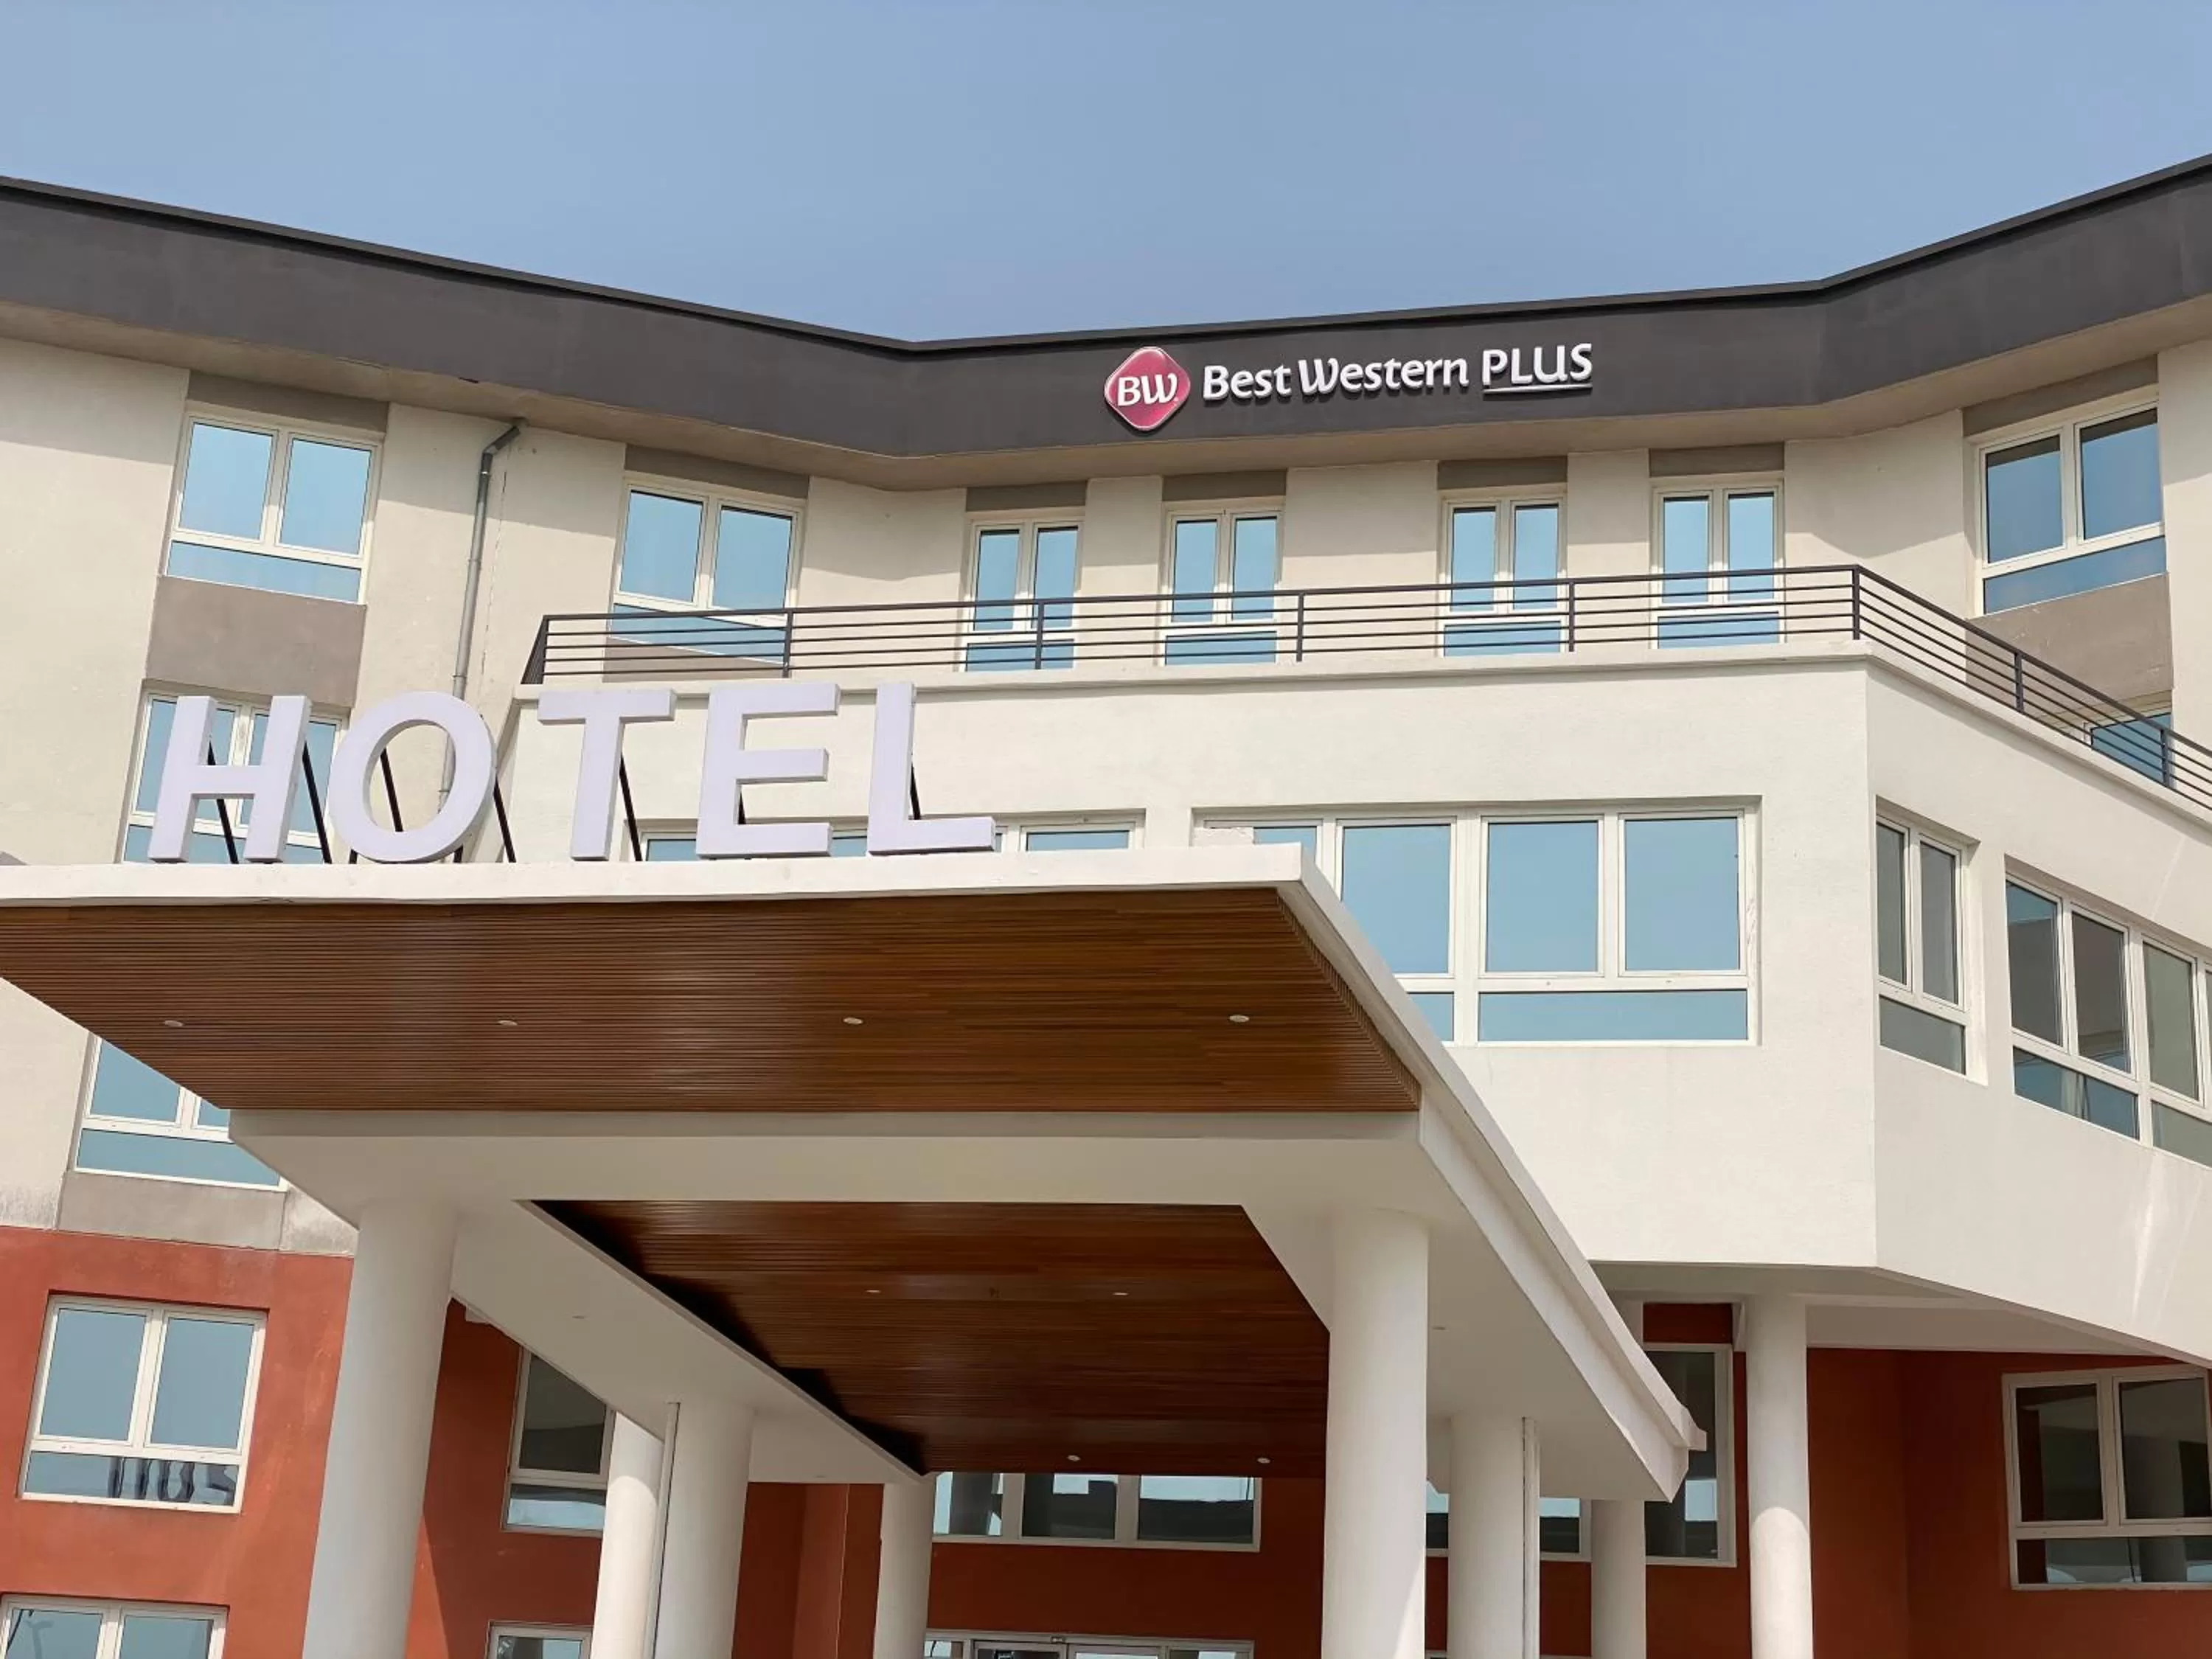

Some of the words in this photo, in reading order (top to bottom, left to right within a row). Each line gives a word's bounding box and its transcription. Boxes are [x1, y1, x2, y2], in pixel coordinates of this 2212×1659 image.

[1117, 372, 1178, 406] BW
[1203, 364, 1291, 399] Best
[1298, 357, 1469, 394] Western
[1482, 342, 1593, 384] PLUS
[148, 681, 995, 863] HOTEL
